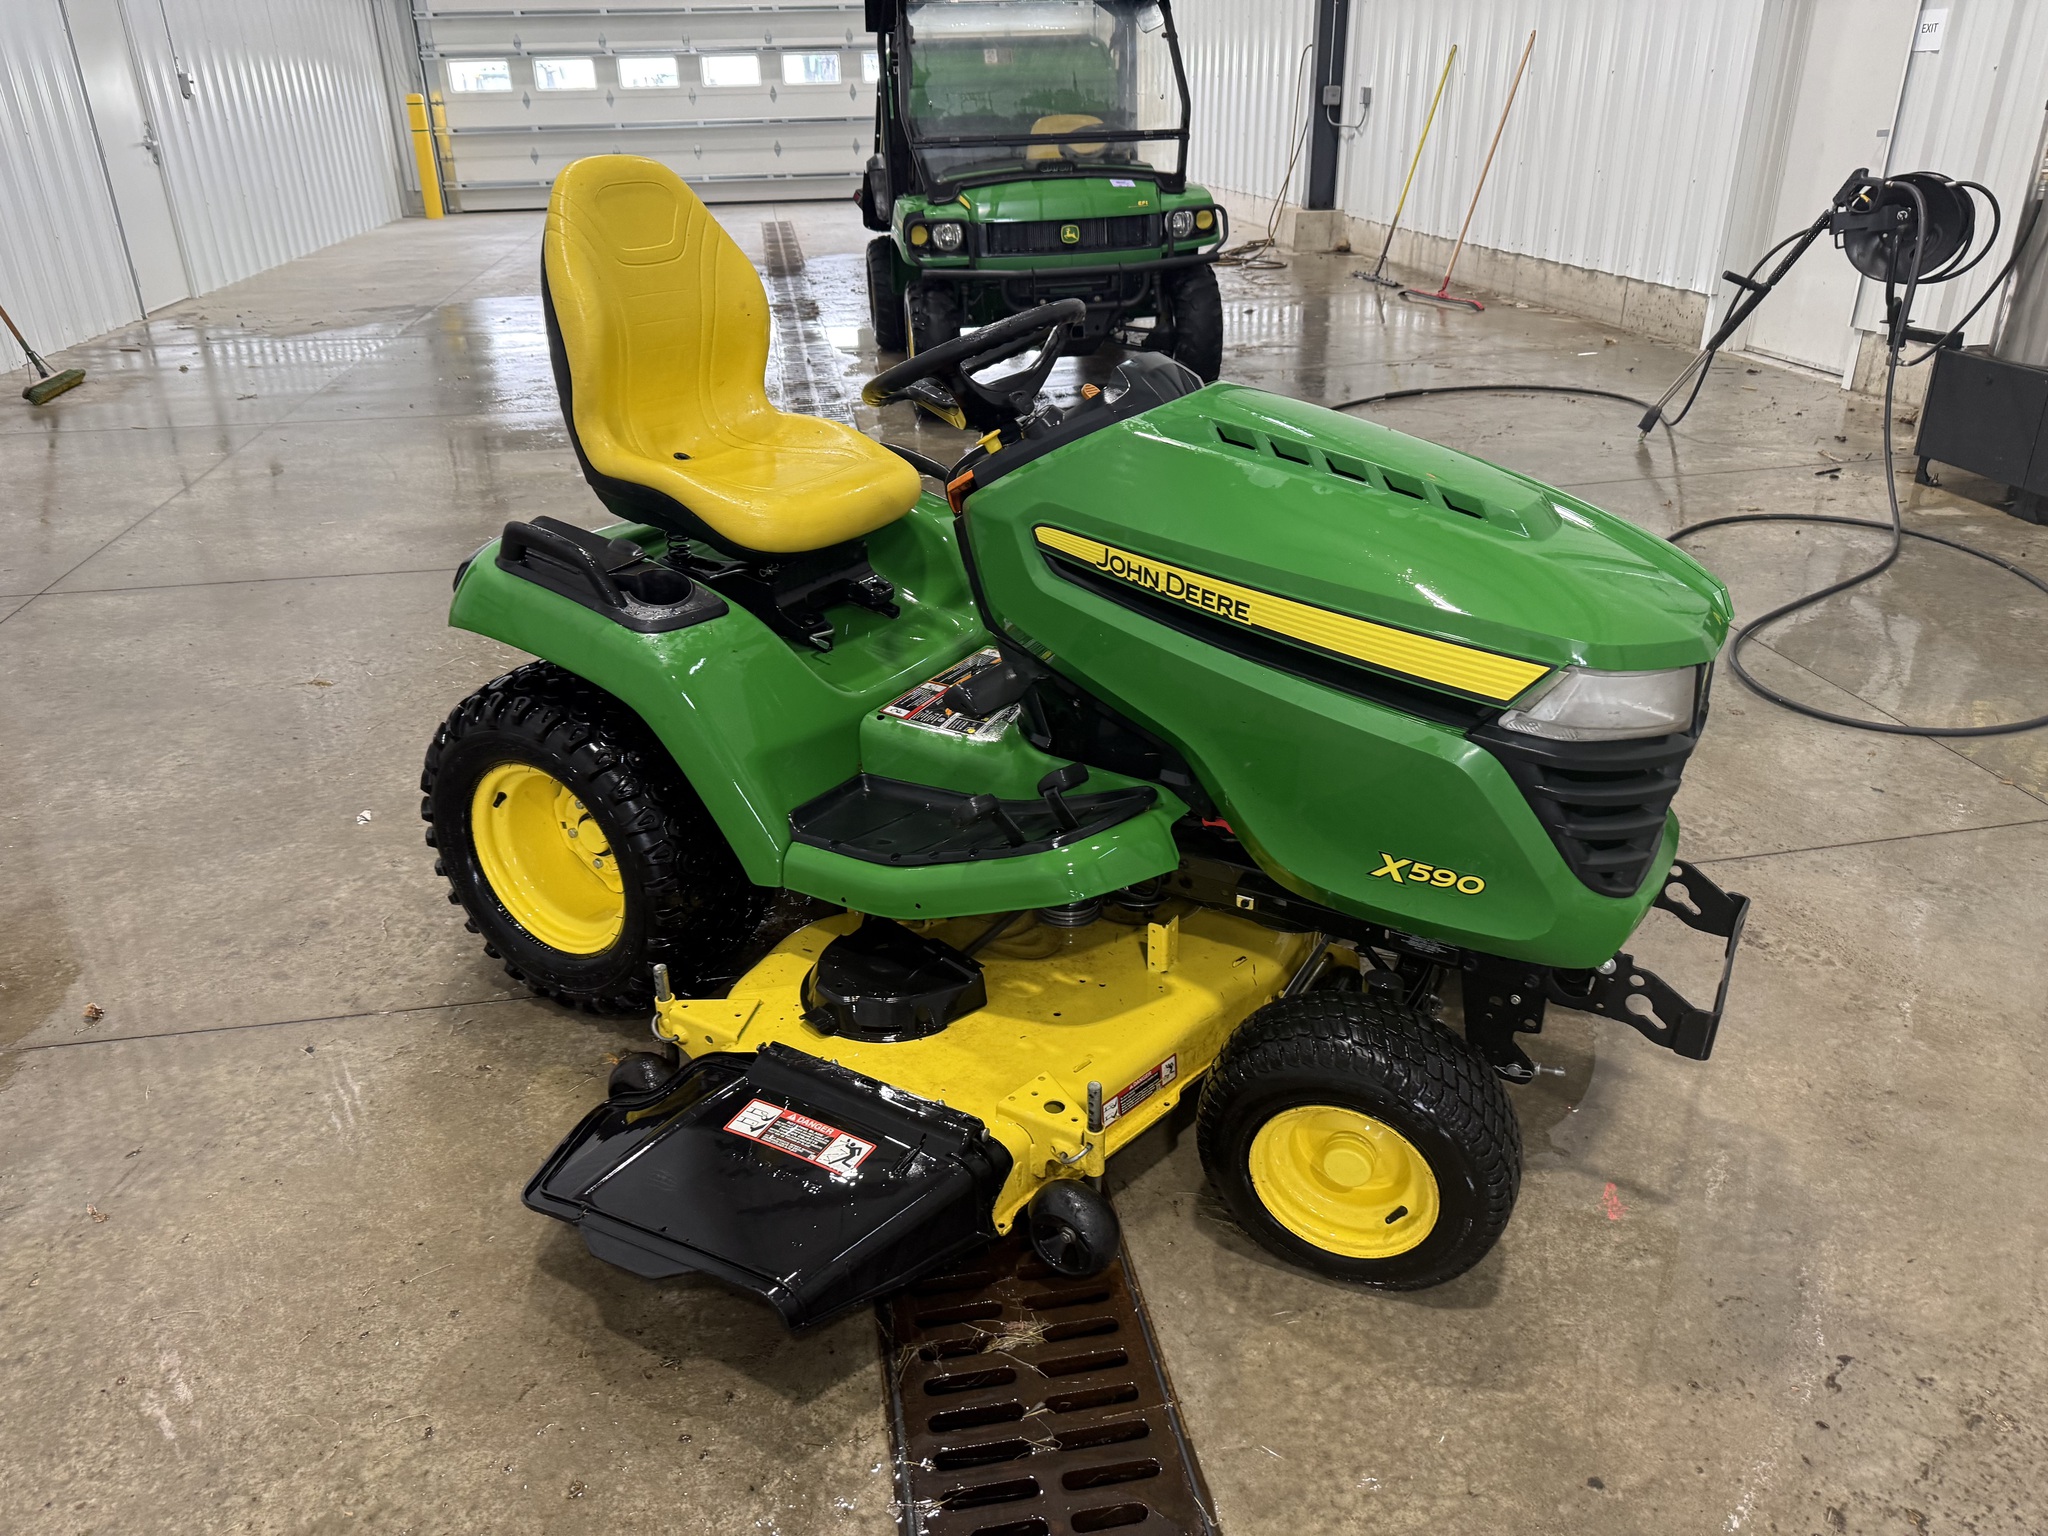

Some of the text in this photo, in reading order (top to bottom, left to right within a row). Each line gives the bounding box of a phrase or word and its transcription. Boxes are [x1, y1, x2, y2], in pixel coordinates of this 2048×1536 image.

[1921, 22, 1939, 33] EXIT
[1096, 548, 1251, 623] JOHN DEERE
[1367, 851, 1486, 895] X590
[796, 1116, 835, 1135] DANGER
